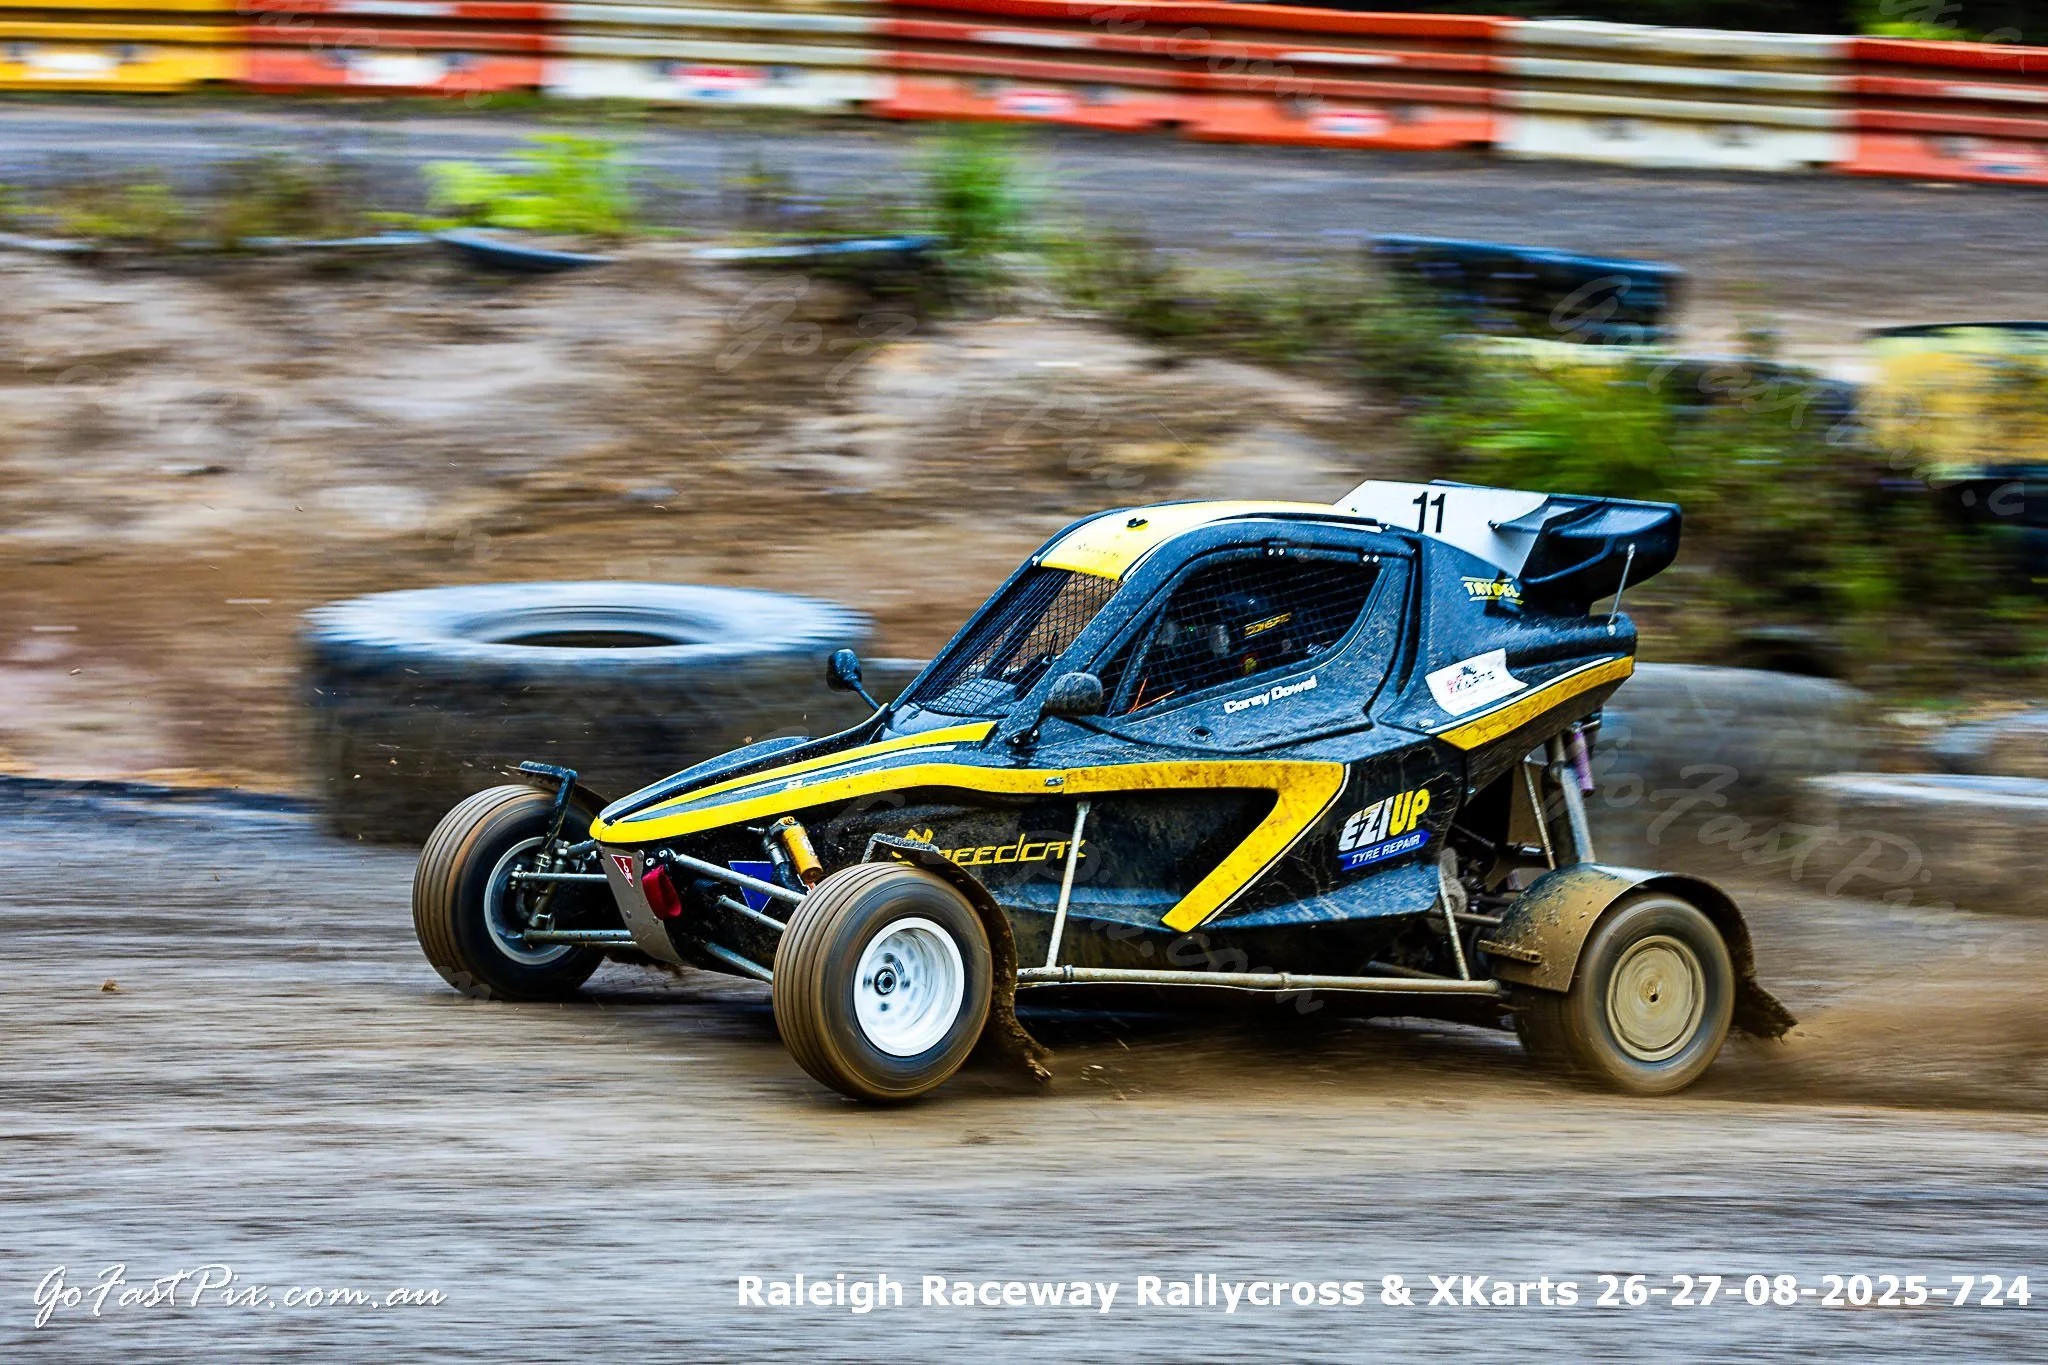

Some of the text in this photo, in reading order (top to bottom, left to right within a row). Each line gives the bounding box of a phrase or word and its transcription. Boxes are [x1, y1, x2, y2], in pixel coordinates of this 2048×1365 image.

[1412, 491, 1447, 534] 11
[1351, 834, 1421, 865] TYRE REPAIR
